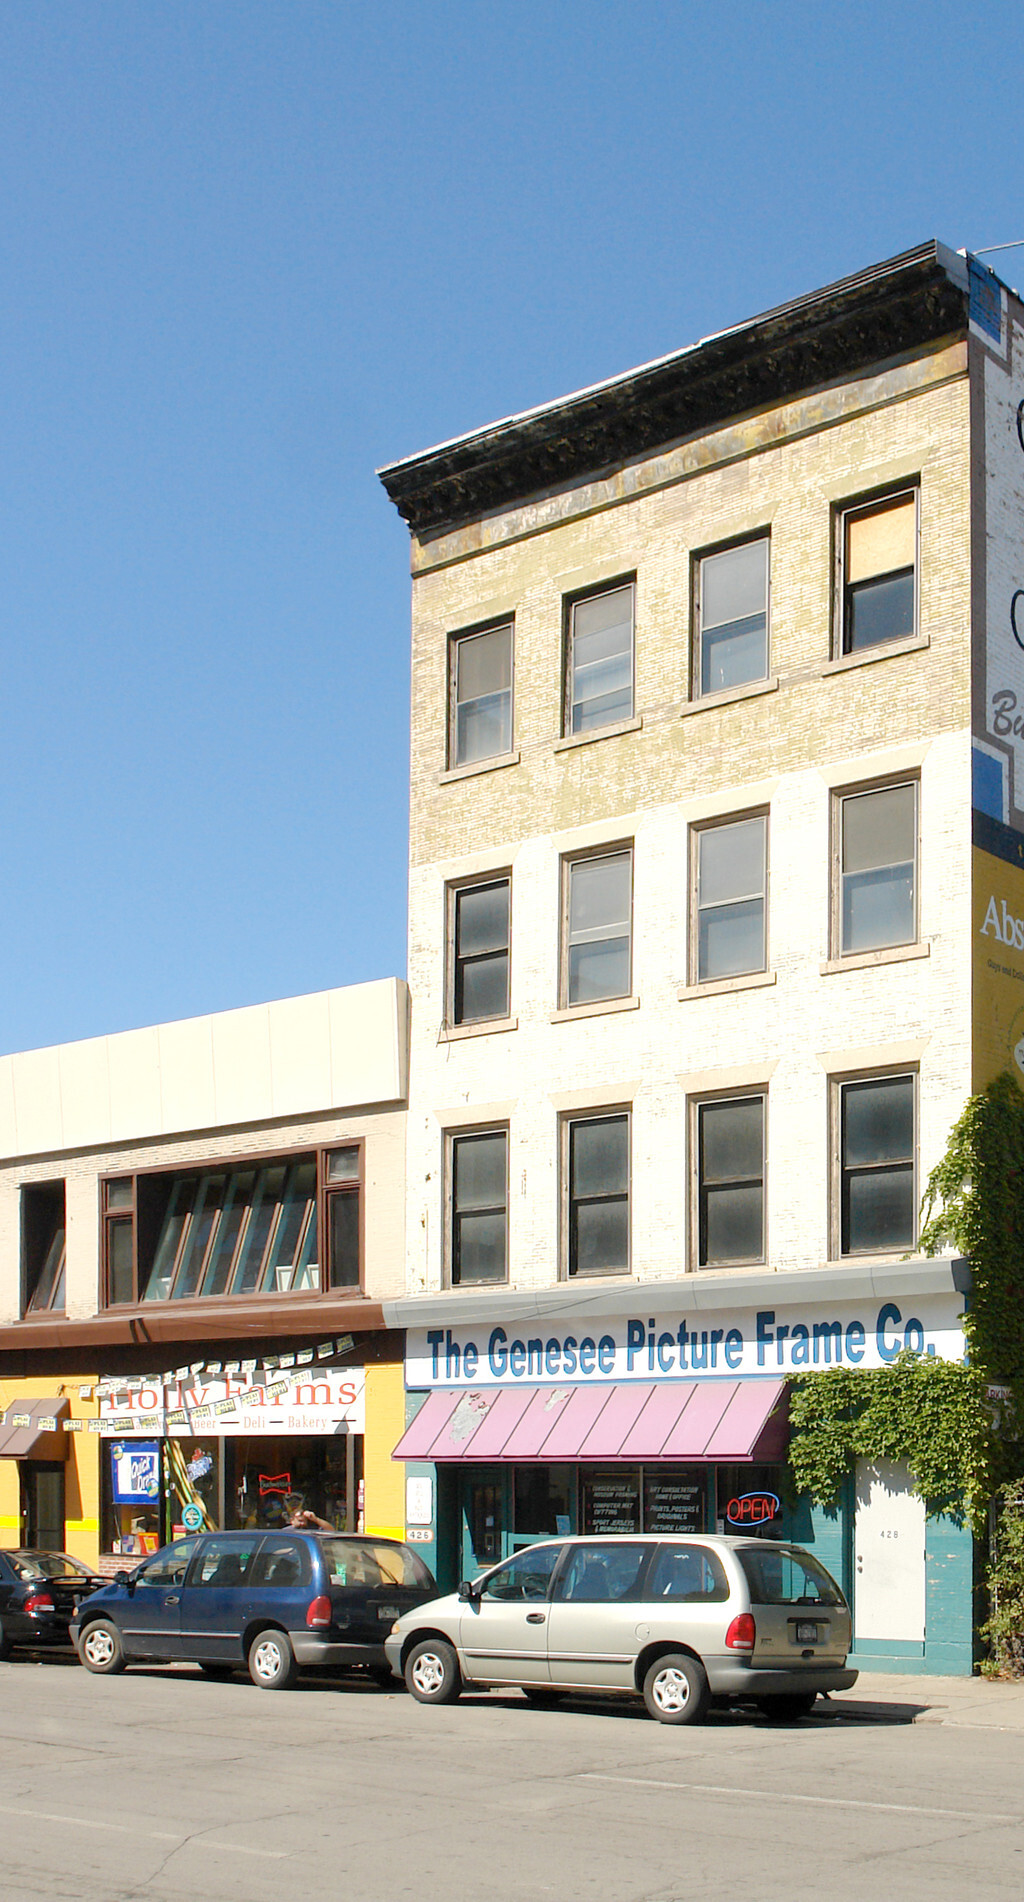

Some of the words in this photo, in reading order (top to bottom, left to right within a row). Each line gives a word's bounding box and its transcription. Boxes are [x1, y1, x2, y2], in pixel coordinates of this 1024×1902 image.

[427, 1329, 478, 1379] The
[488, 1326, 615, 1377] Genesee
[627, 1317, 743, 1372] Picture
[756, 1311, 865, 1366] Frame
[876, 1302, 936, 1363] Co.
[193, 1418, 217, 1429] Beer
[243, 1416, 266, 1429] Deli
[288, 1415, 328, 1431] Bakery
[131, 1455, 151, 1479] Quick
[726, 1497, 776, 1520] OPEN
[650, 1524, 675, 1532] PICTURE
[675, 1524, 696, 1532] LIGHTS
[880, 1530, 899, 1539] 428
